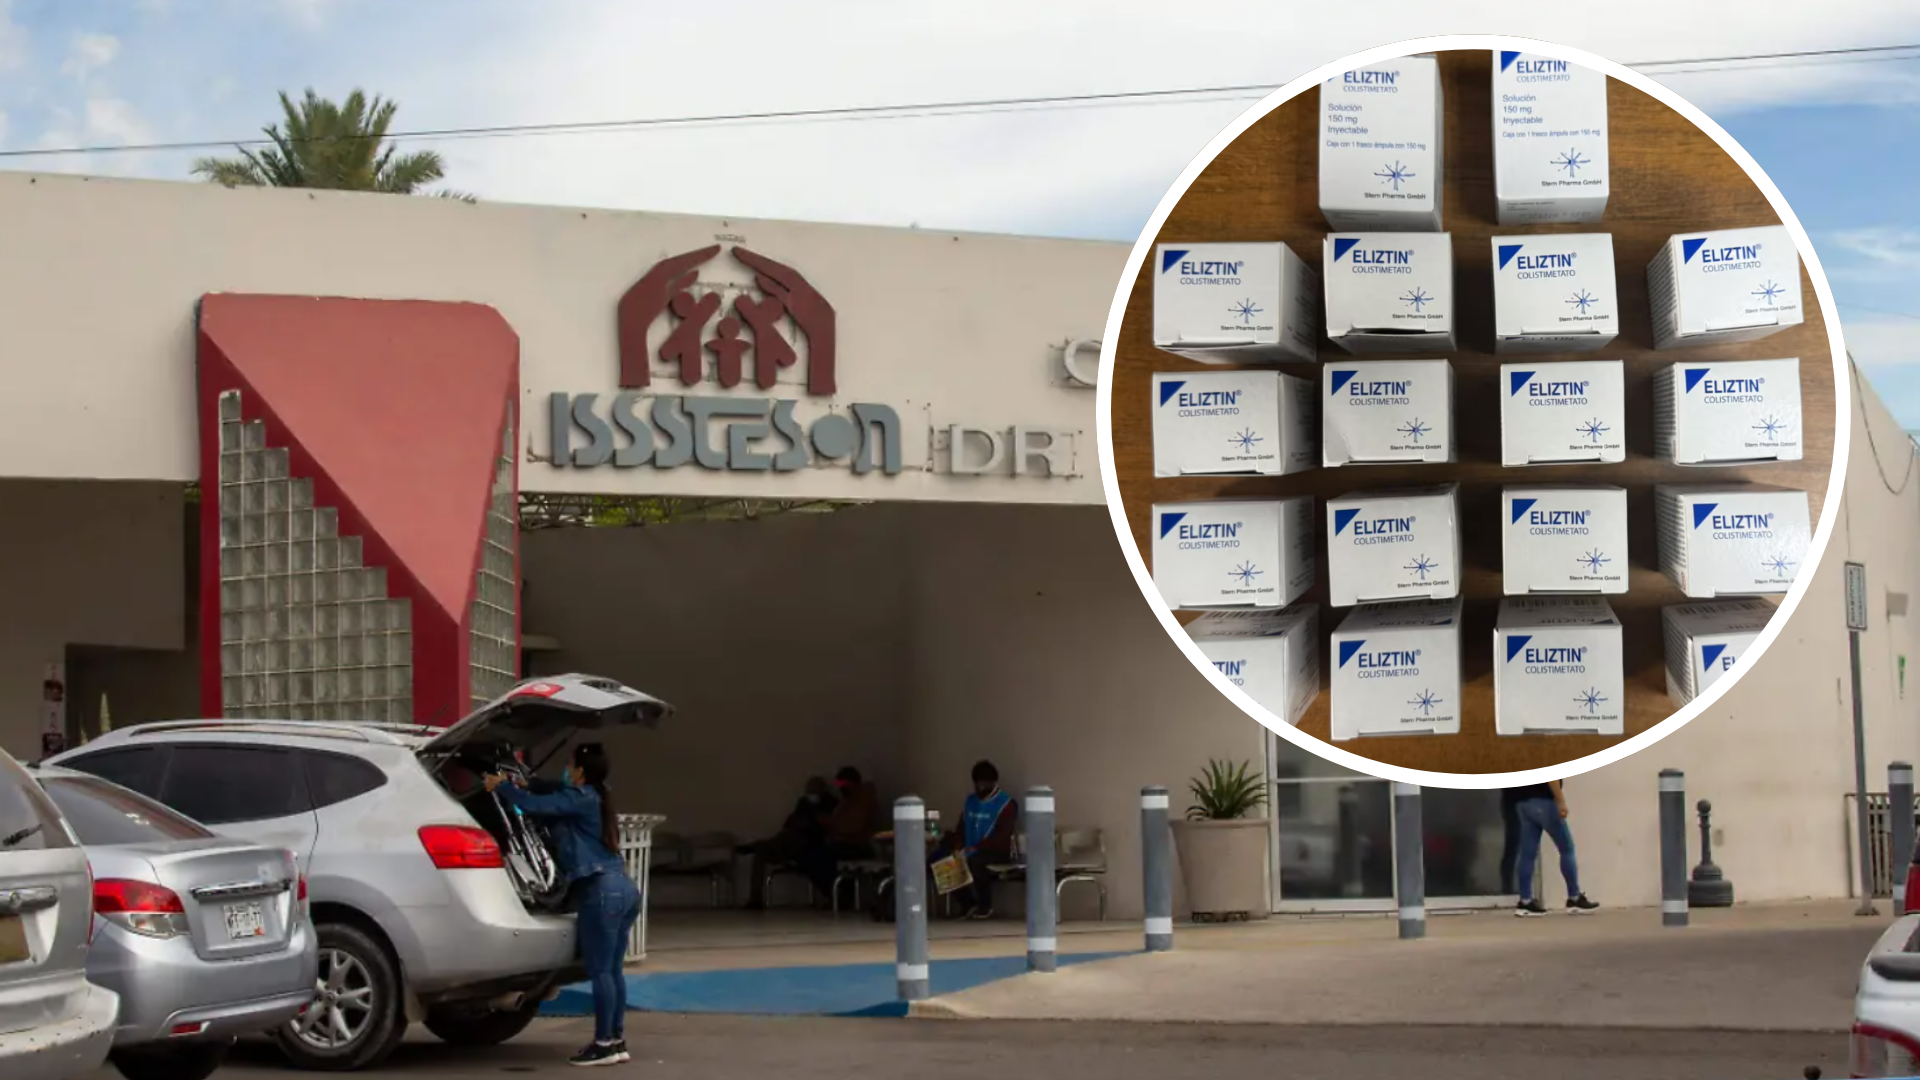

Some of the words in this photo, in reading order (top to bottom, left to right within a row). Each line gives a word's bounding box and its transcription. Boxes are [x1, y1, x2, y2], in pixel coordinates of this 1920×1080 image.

[1517, 75, 1570, 83] COLISTIMETATO
[1343, 85, 1397, 93] COLISTIMETATO
[1503, 94, 1536, 102] Solución
[1328, 103, 1362, 112] Solución
[1345, 116, 1357, 124] mg
[1503, 117, 1542, 125] Inyectable
[1328, 126, 1368, 134] Inyectable
[1352, 266, 1412, 274] COLISTIMETATO
[1702, 260, 1761, 273] COLISTIMETATO
[1517, 269, 1576, 279] COLISTIMETATO
[1180, 277, 1241, 285] COLISTIMETATO
[1350, 397, 1409, 406] COLISTIMETATO
[1529, 398, 1588, 406] COLISTIMETATO
[1704, 395, 1763, 403] COLISTIMETATO
[1179, 407, 1239, 417] COLISTIMETATO
[1530, 527, 1589, 536] COLISTIMETATO
[1713, 531, 1773, 539] COLISTIMETATO
[1354, 534, 1414, 545] COLISTIMETATO
[1179, 539, 1240, 549] COLISTIMETATO
[1358, 669, 1419, 678] COLISTIMETATO
[1525, 665, 1585, 674] COLISTIMETATO
